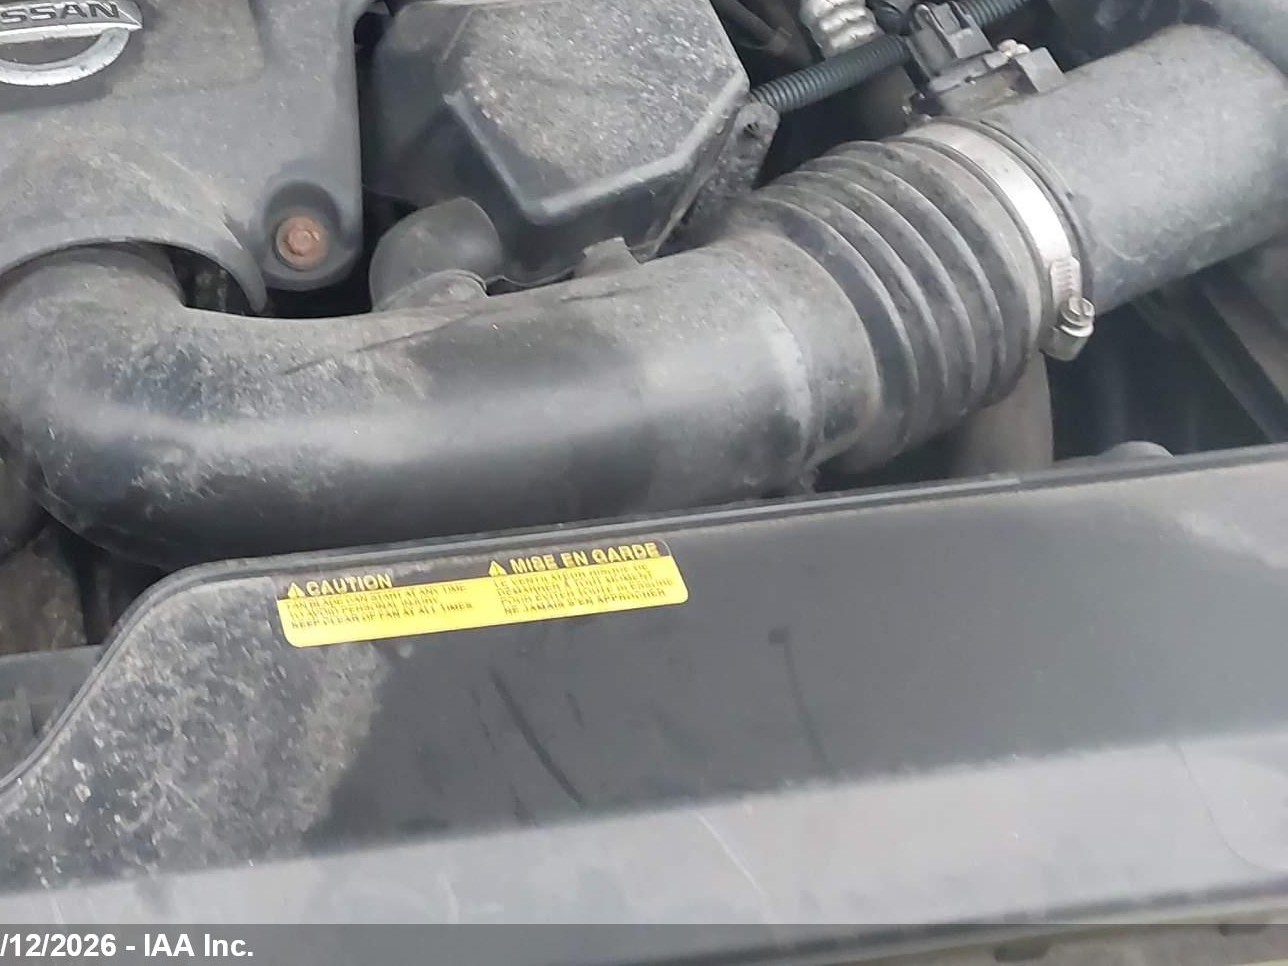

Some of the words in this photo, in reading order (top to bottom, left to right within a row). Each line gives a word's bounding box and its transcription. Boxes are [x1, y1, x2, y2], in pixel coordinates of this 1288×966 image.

[510, 553, 559, 574] MISE
[560, 550, 589, 568] EN
[591, 542, 661, 564] GARDE
[306, 573, 393, 596] CAUTION
